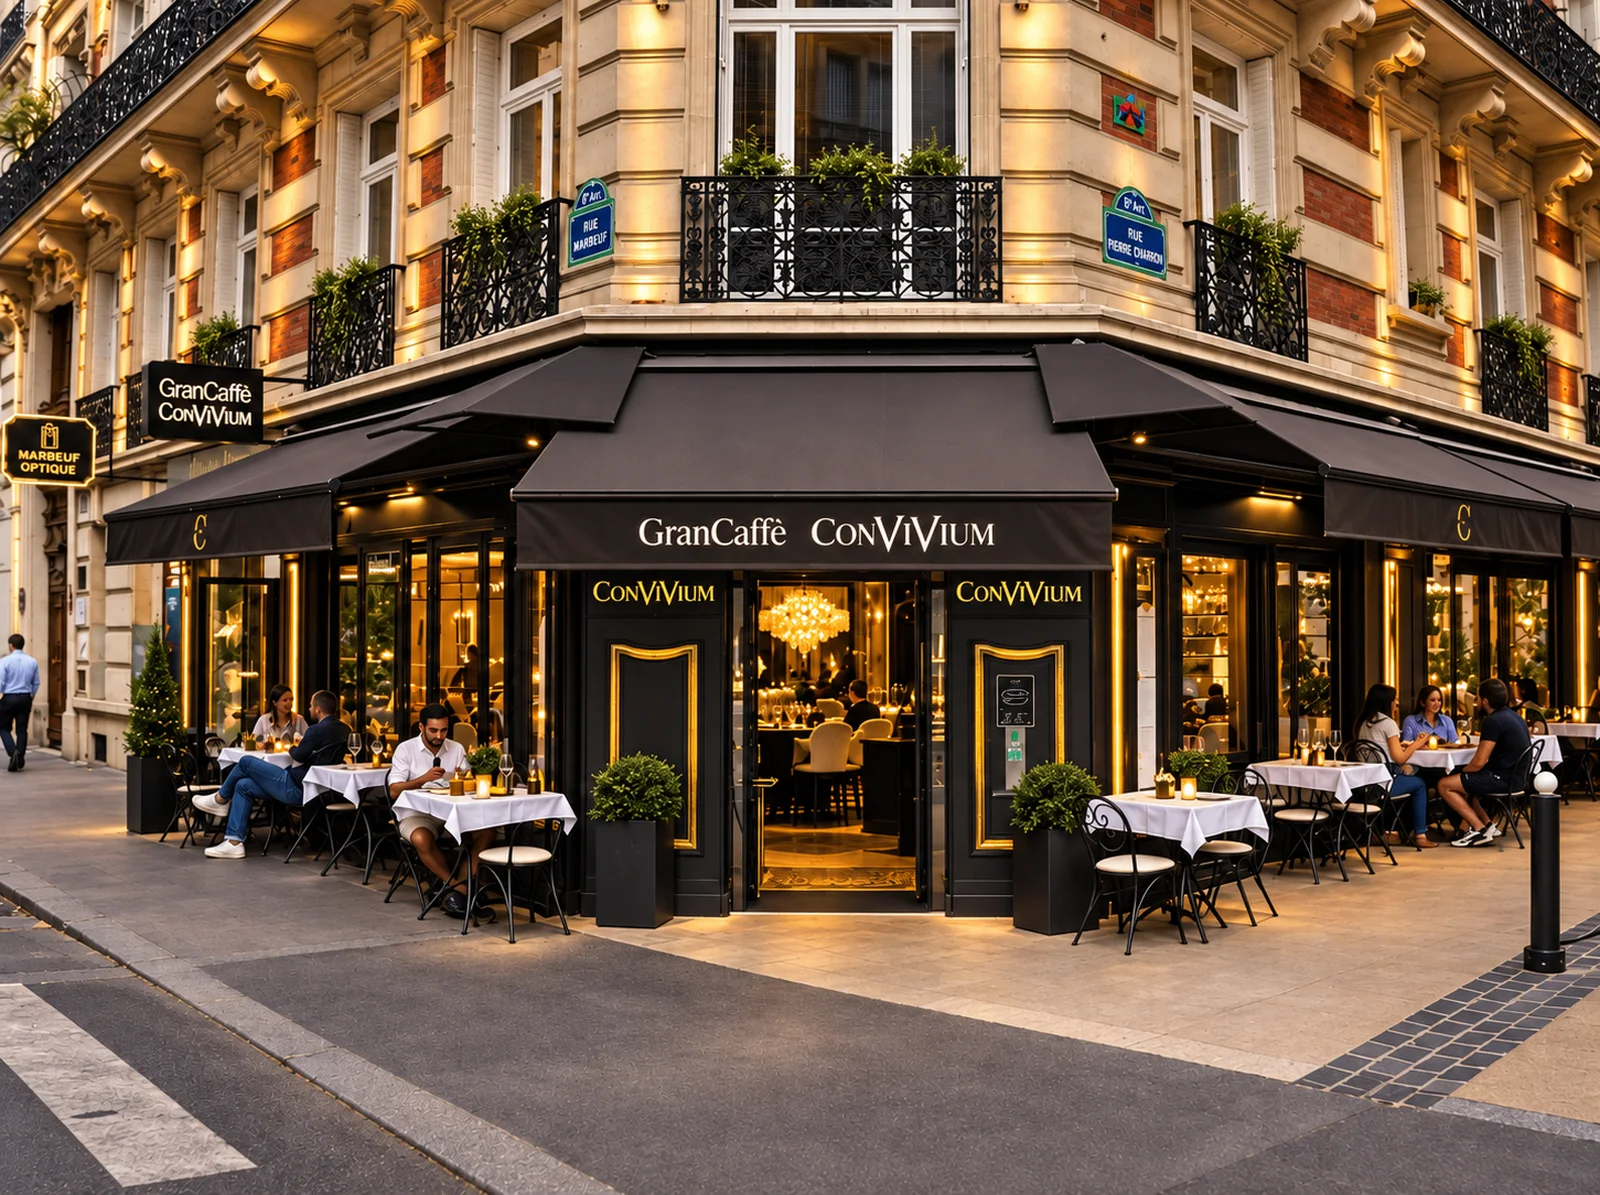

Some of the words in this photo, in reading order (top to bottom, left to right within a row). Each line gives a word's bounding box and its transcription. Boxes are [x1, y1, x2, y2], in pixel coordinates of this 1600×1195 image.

[583, 217, 599, 233] RUE
[573, 231, 608, 252] MARBEUF
[1127, 227, 1143, 243] RUE
[159, 377, 252, 405] GranCaffè
[18, 449, 81, 463] MARBEUF
[20, 462, 77, 475] OPTIQUE
[638, 517, 787, 547] GranCaffè
